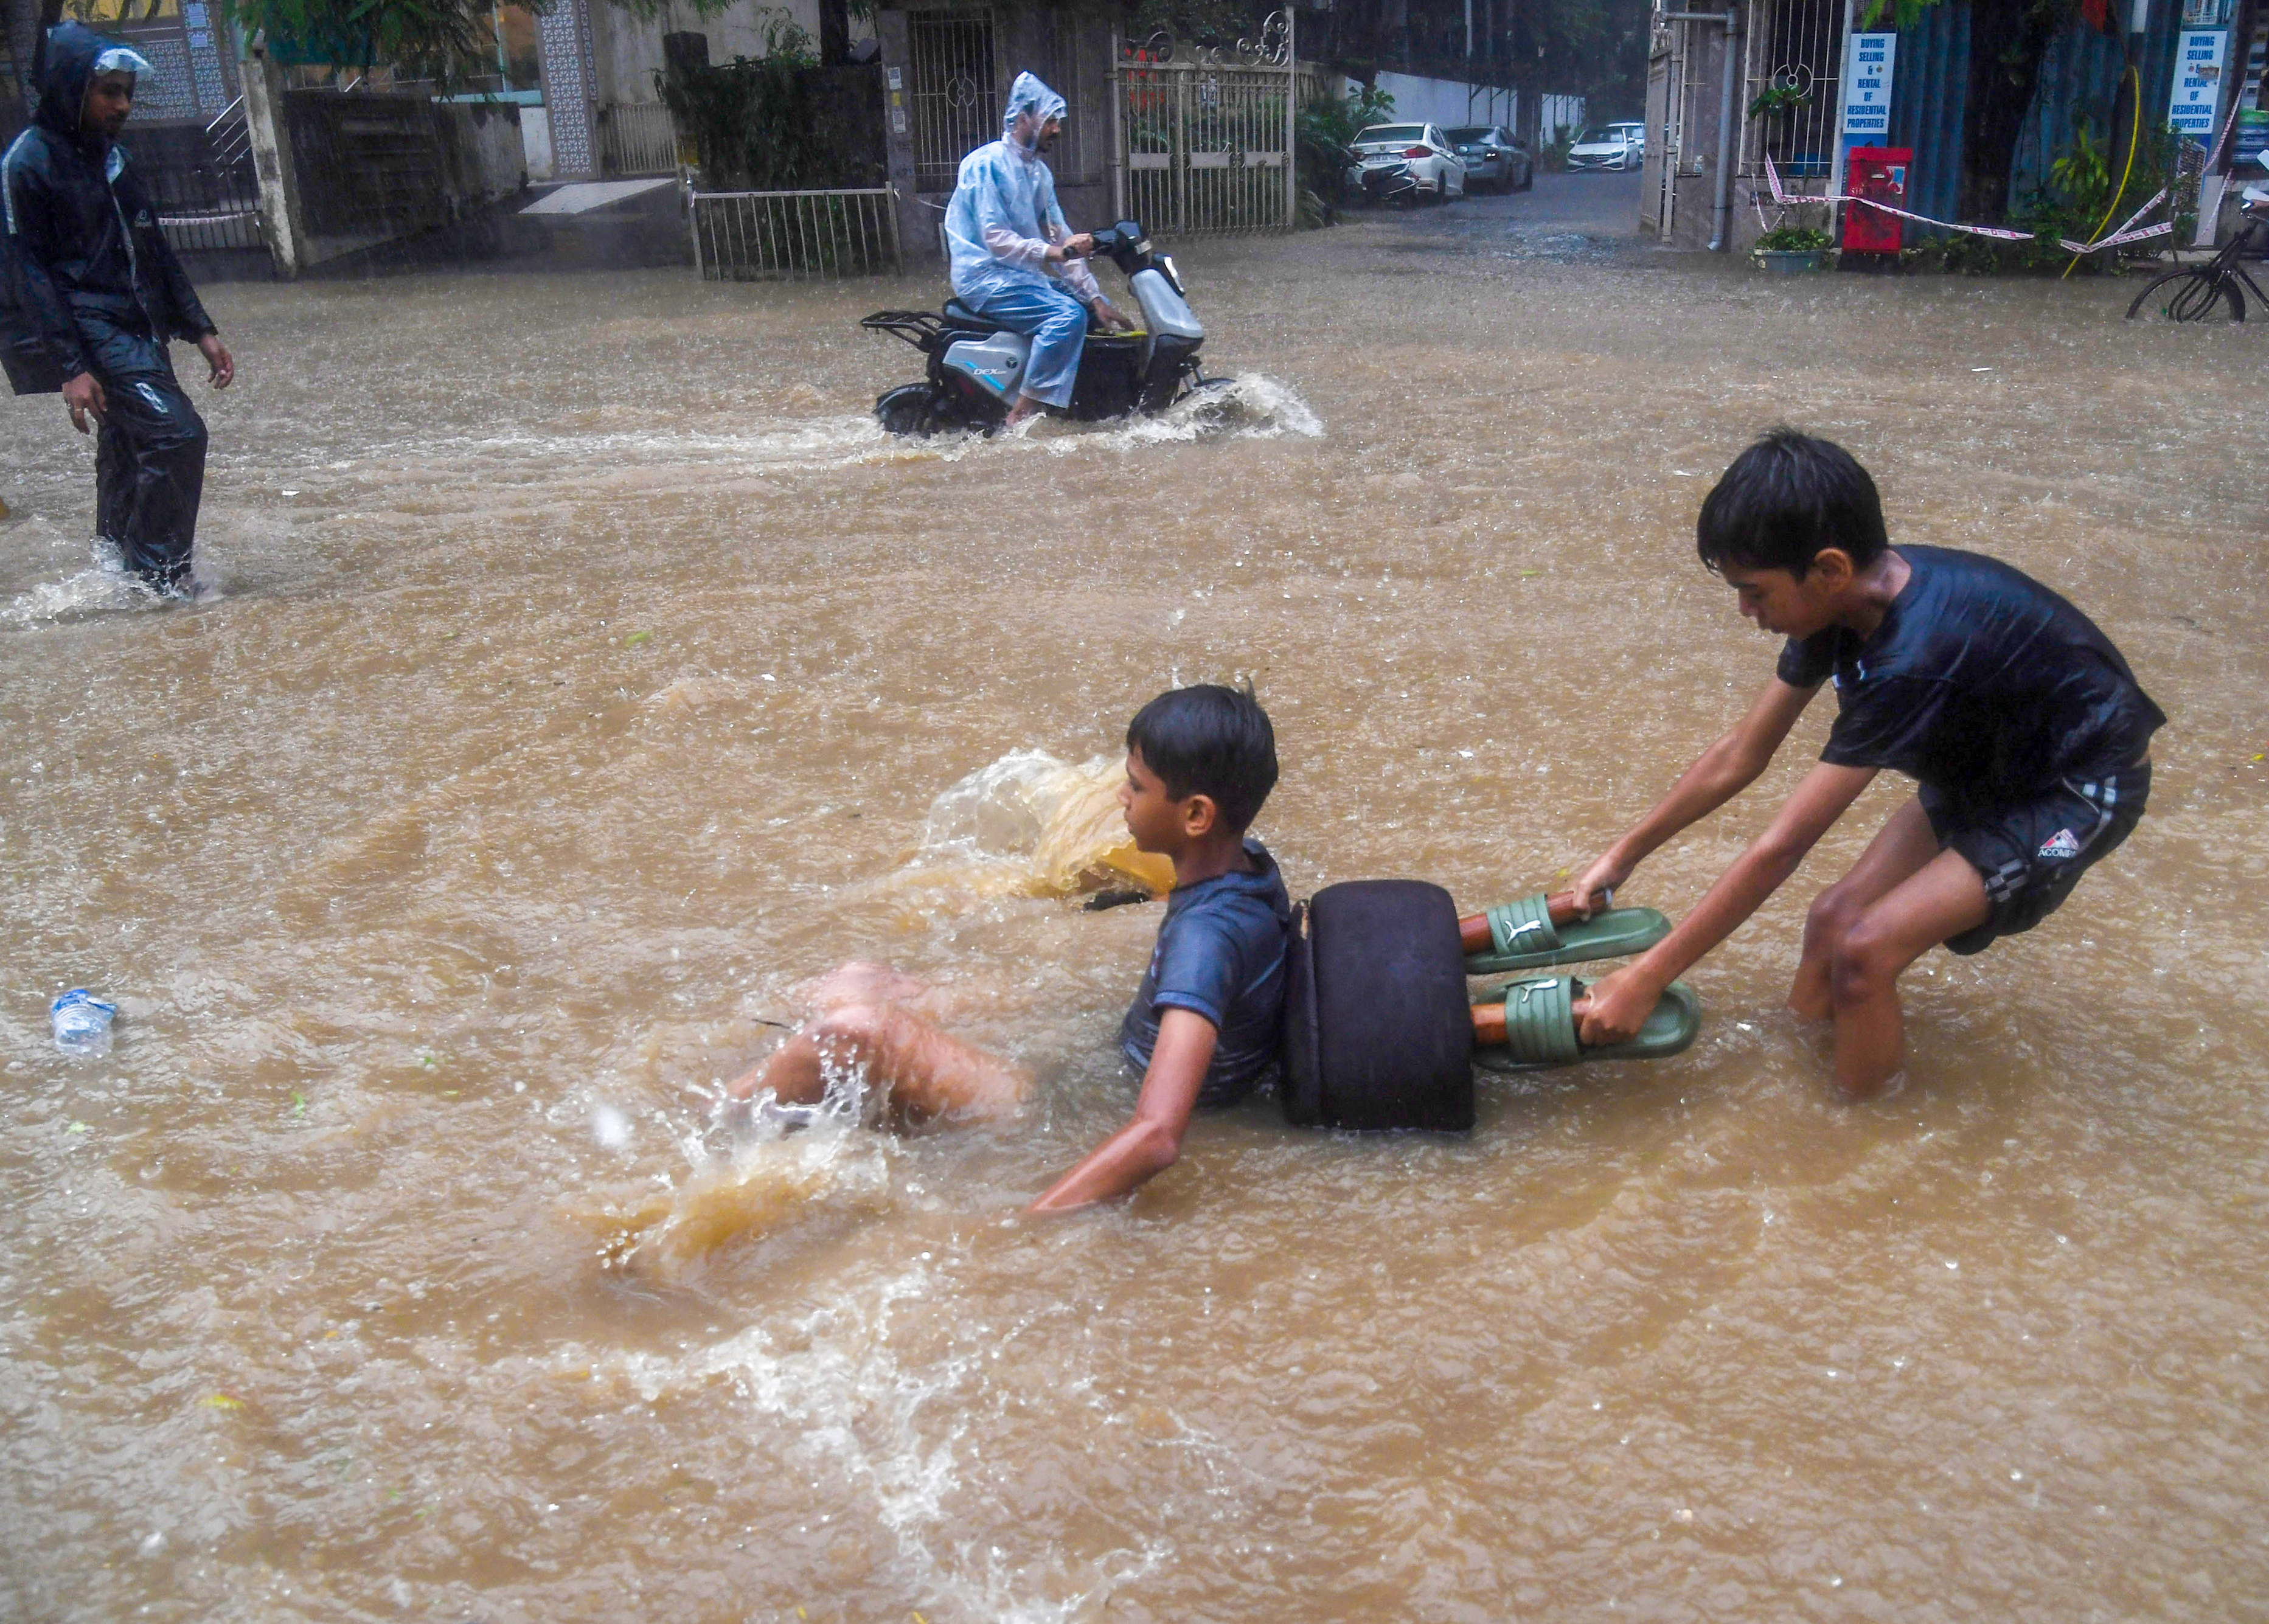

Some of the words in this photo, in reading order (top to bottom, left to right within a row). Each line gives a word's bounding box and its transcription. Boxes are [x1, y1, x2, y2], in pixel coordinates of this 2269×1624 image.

[1861, 38, 1885, 48] BUYING
[2190, 36, 2215, 46] BUYING
[1858, 52, 1884, 61] SELLING
[2187, 50, 2213, 60] SELLING
[1868, 66, 1872, 75] &
[1858, 78, 1880, 88] RENTAL
[2184, 78, 2208, 87] RENTAL
[1864, 92, 1872, 102] OF
[2190, 91, 2199, 101] OF
[1847, 105, 1886, 115] RESIDENTIAL
[2172, 105, 2212, 114] RESIDENTIAL
[1847, 119, 1884, 128] PROPERTIES
[2172, 118, 2209, 128] PROPERTIES
